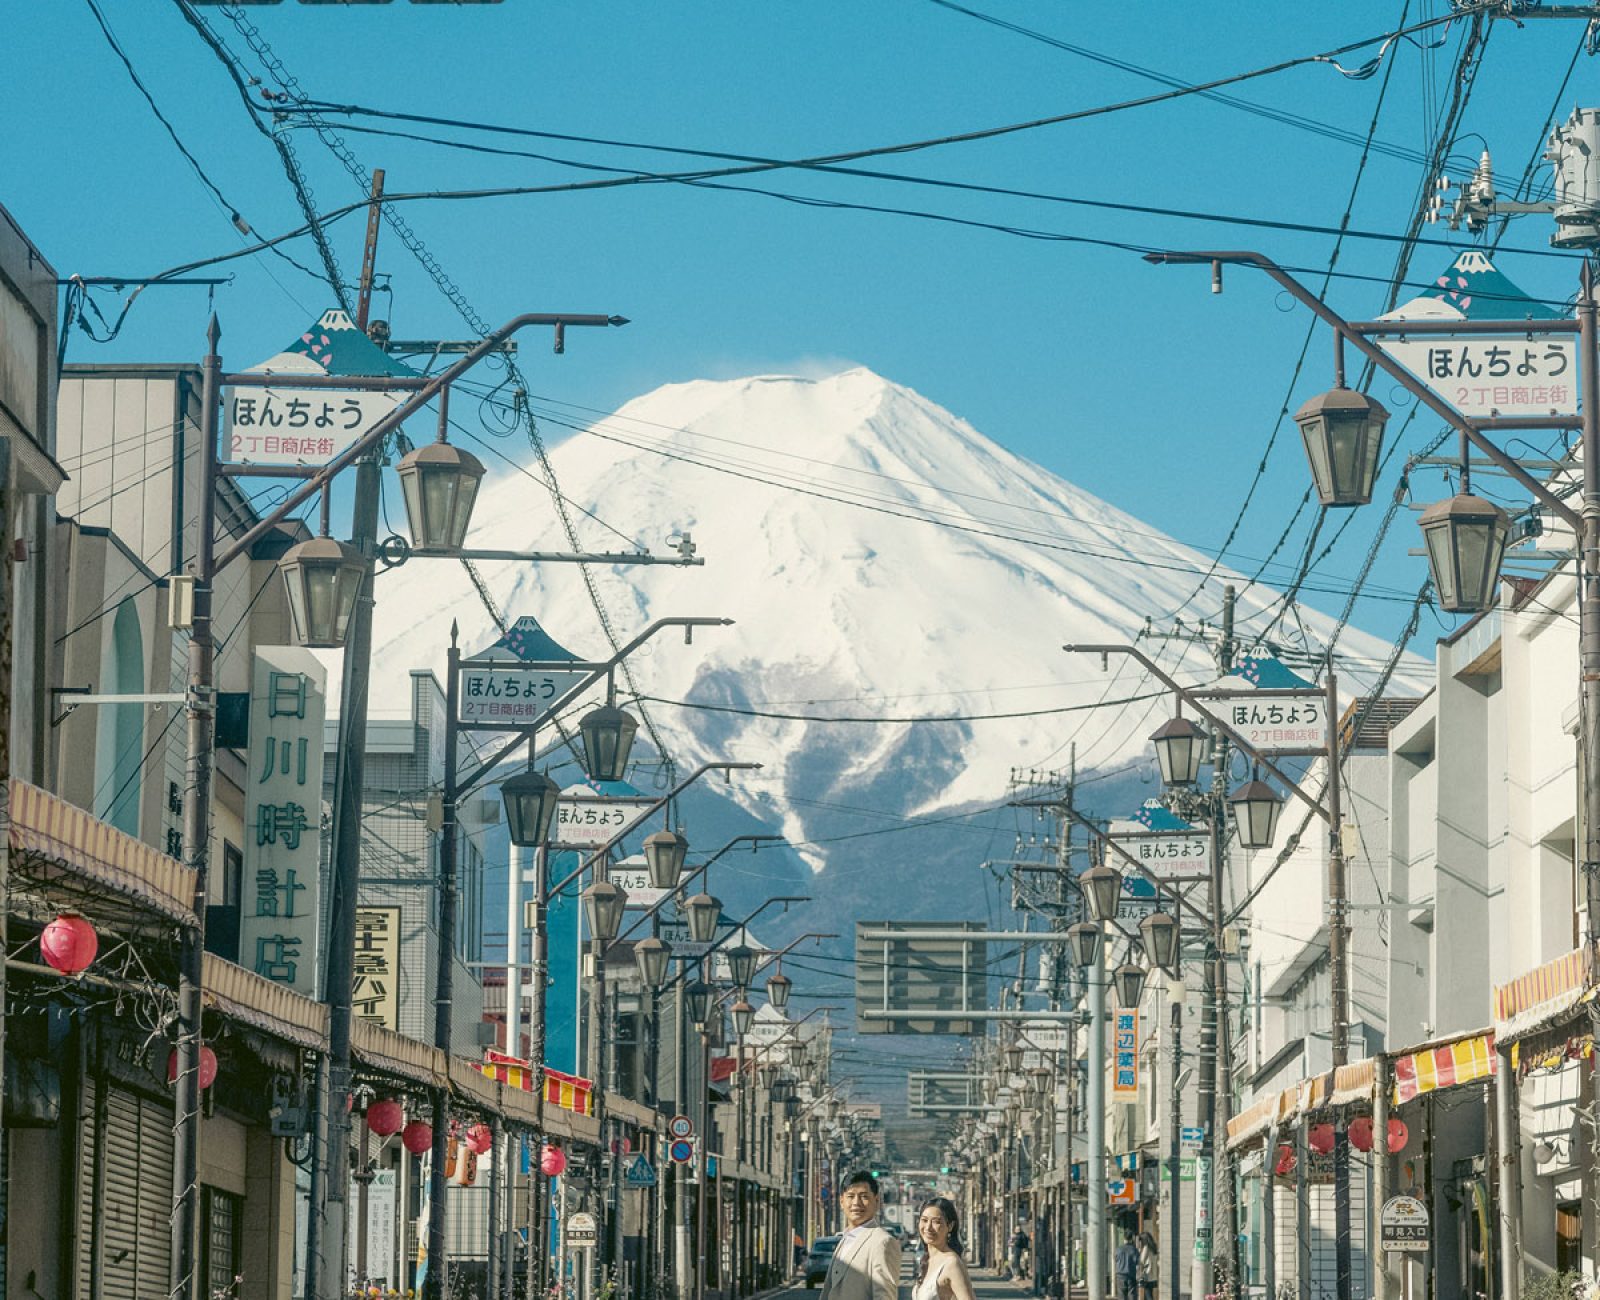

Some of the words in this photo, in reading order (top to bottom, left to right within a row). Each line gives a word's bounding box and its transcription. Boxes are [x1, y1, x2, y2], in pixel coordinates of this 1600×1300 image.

[1428, 344, 1568, 378] ほんちょう
[1456, 385, 1568, 406] 2丁目商店街
[232, 397, 363, 429] ほんちょう
[230, 435, 335, 456] 2丁目商店街
[467, 676, 556, 699] ほんちょう
[466, 703, 537, 716] 2丁目商店街
[1233, 703, 1319, 725] ほんちょう
[1251, 730, 1319, 742] 2丁目商店街
[256, 671, 308, 984] 日川時計店
[557, 808, 625, 826] ほんちょう
[1139, 841, 1205, 858] ほんちょう
